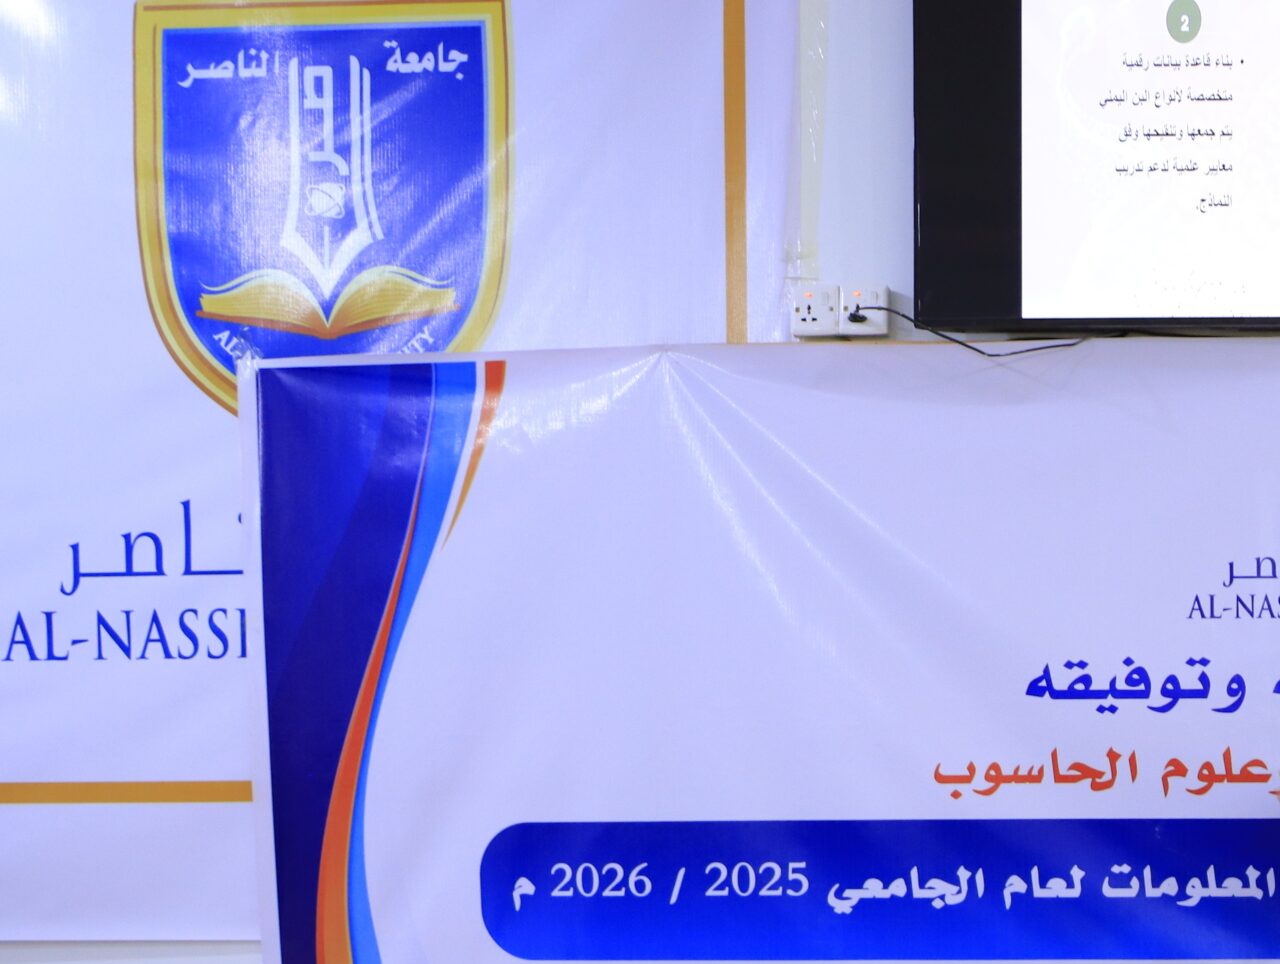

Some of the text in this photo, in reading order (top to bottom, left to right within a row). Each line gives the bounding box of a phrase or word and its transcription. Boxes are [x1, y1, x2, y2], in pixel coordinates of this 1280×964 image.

[1180, 14, 1190, 32] 2
[177, 40, 469, 88] جامعة الناصر
[1153, 54, 1181, 71] بيانات
[1185, 52, 1211, 68] قاعدة
[60, 498, 244, 596] اصر
[1024, 655, 1247, 715] وتوفيقه
[932, 745, 1138, 800] الحاسوب
[512, 875, 537, 912] م
[549, 862, 653, 898] 2026
[669, 866, 686, 906] /
[704, 861, 810, 897] 2025
[827, 864, 985, 915] الجامعي
[1003, 863, 1087, 910] لعام
[1101, 862, 1276, 907] المعلومات
